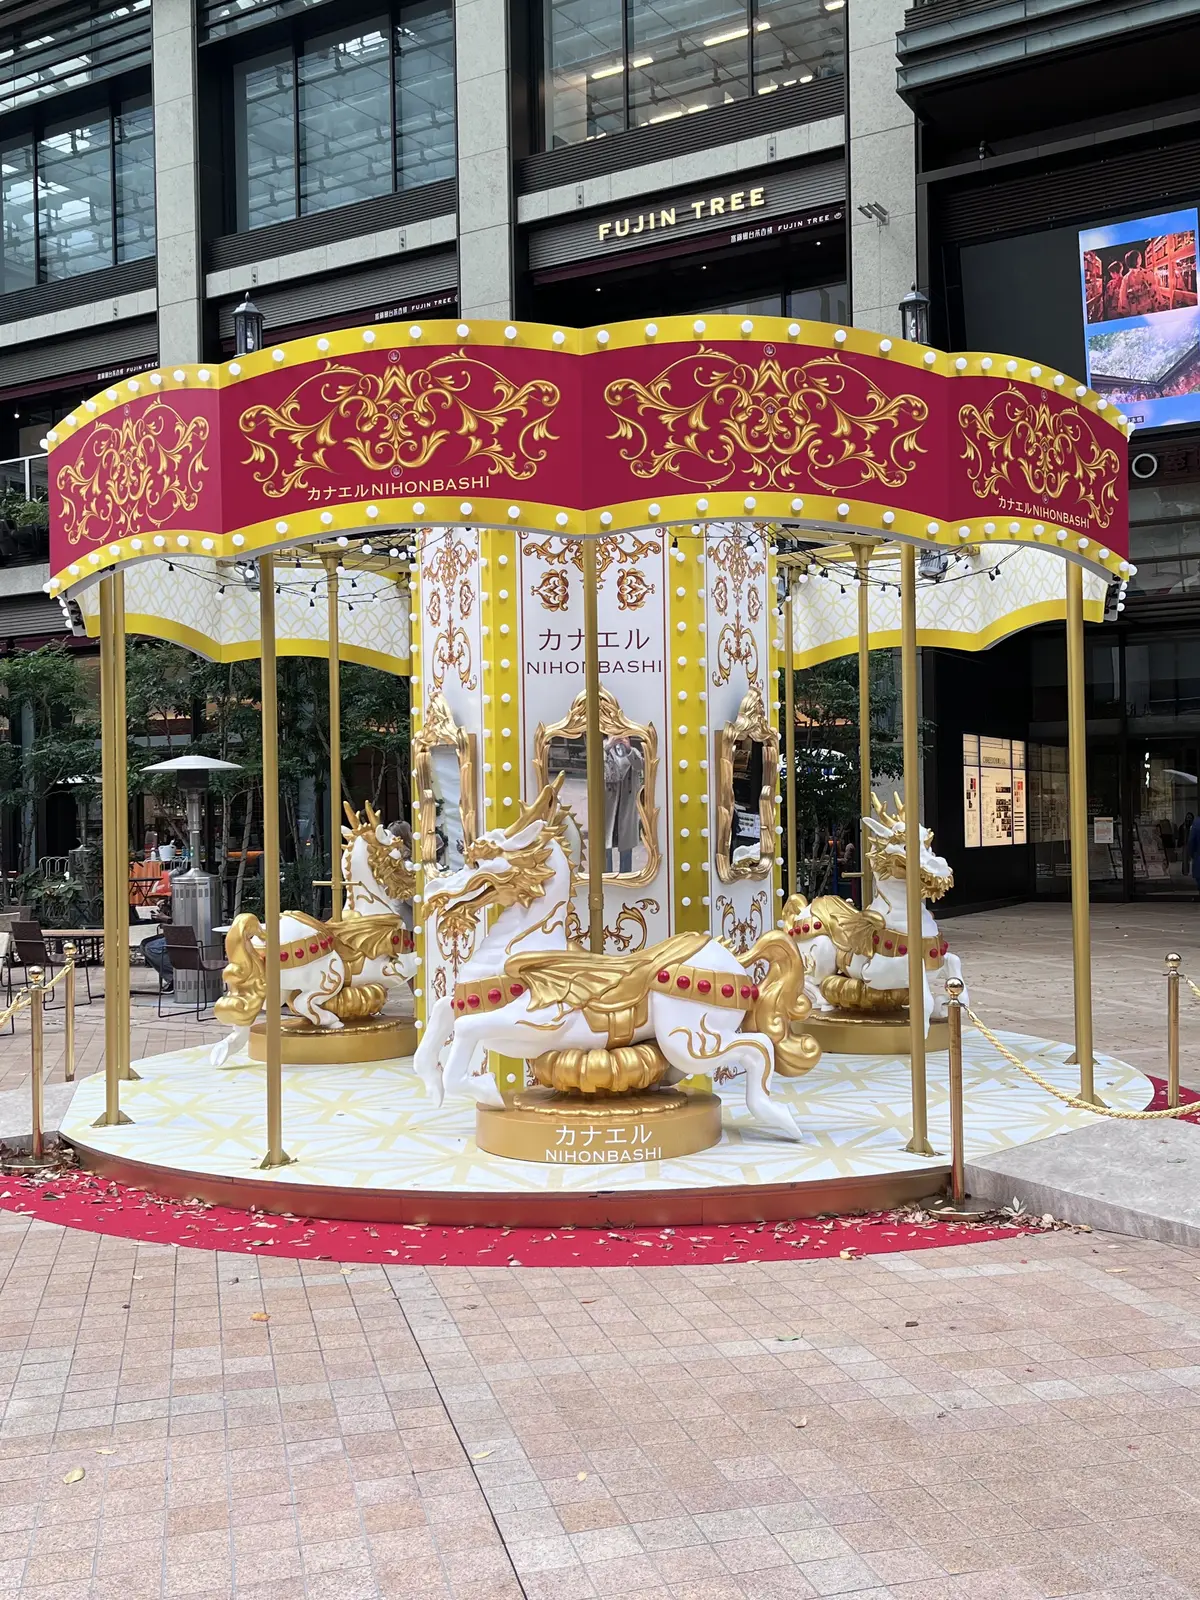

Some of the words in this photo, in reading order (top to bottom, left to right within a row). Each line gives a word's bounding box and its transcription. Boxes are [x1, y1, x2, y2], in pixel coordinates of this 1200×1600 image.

[598, 207, 676, 241] FUJIN
[691, 187, 765, 219] TREE
[777, 220, 803, 232] FUJIN
[807, 214, 830, 225] TREE
[411, 302, 431, 311] FUJIN
[433, 297, 452, 306] TREE
[126, 365, 143, 373] FUJIN
[144, 361, 159, 369] TREE
[538, 628, 650, 651] カナエル
[526, 660, 662, 674] NIHOBASHI
[555, 1124, 652, 1147] カナエル
[545, 1146, 662, 1163] NIHONBASHI
